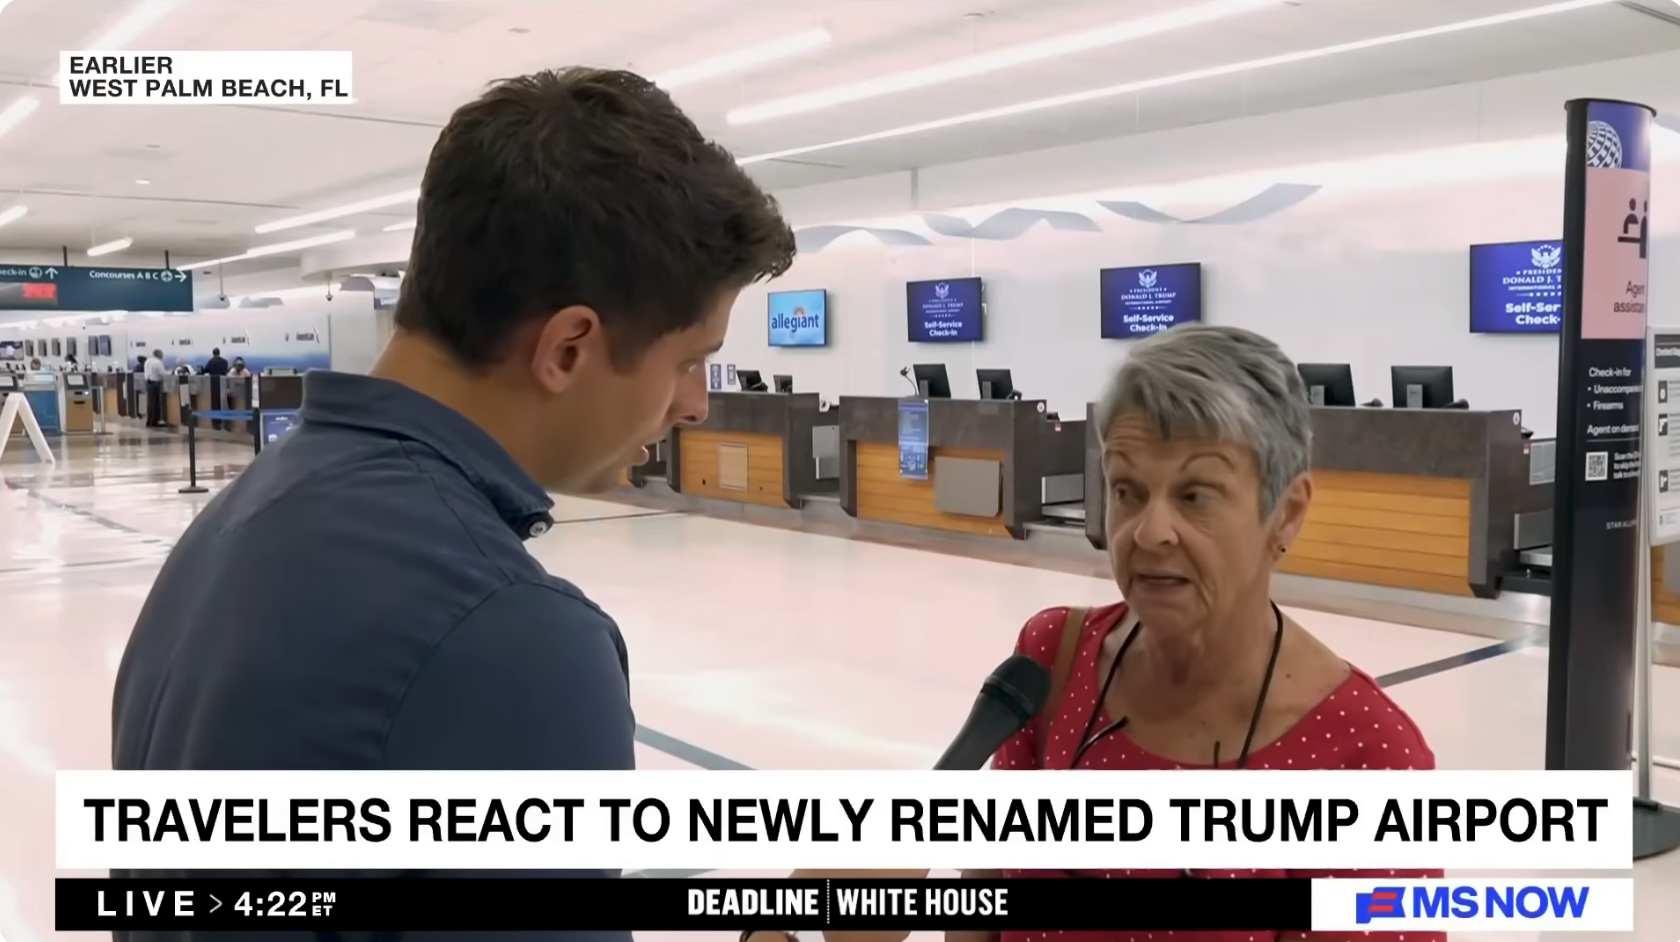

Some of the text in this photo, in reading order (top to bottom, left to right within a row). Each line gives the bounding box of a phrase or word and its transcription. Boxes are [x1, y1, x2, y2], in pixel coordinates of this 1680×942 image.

[0, 267, 27, 276] eck-in
[89, 270, 159, 280] Concourses A B C
[1502, 276, 1545, 285] DONALD
[1546, 275, 1553, 284] J.
[1626, 280, 1646, 298] Agen
[1505, 302, 1562, 313] Self-Ser
[771, 312, 819, 333] allegiant
[1122, 313, 1174, 323] Self-Service
[1515, 314, 1561, 325] Check-
[924, 320, 963, 329] Self-Service
[1129, 323, 1167, 333] Check-In
[1588, 367, 1631, 377] Check-in for
[1593, 400, 1624, 410] Firearms
[1587, 424, 1610, 436] Agent
